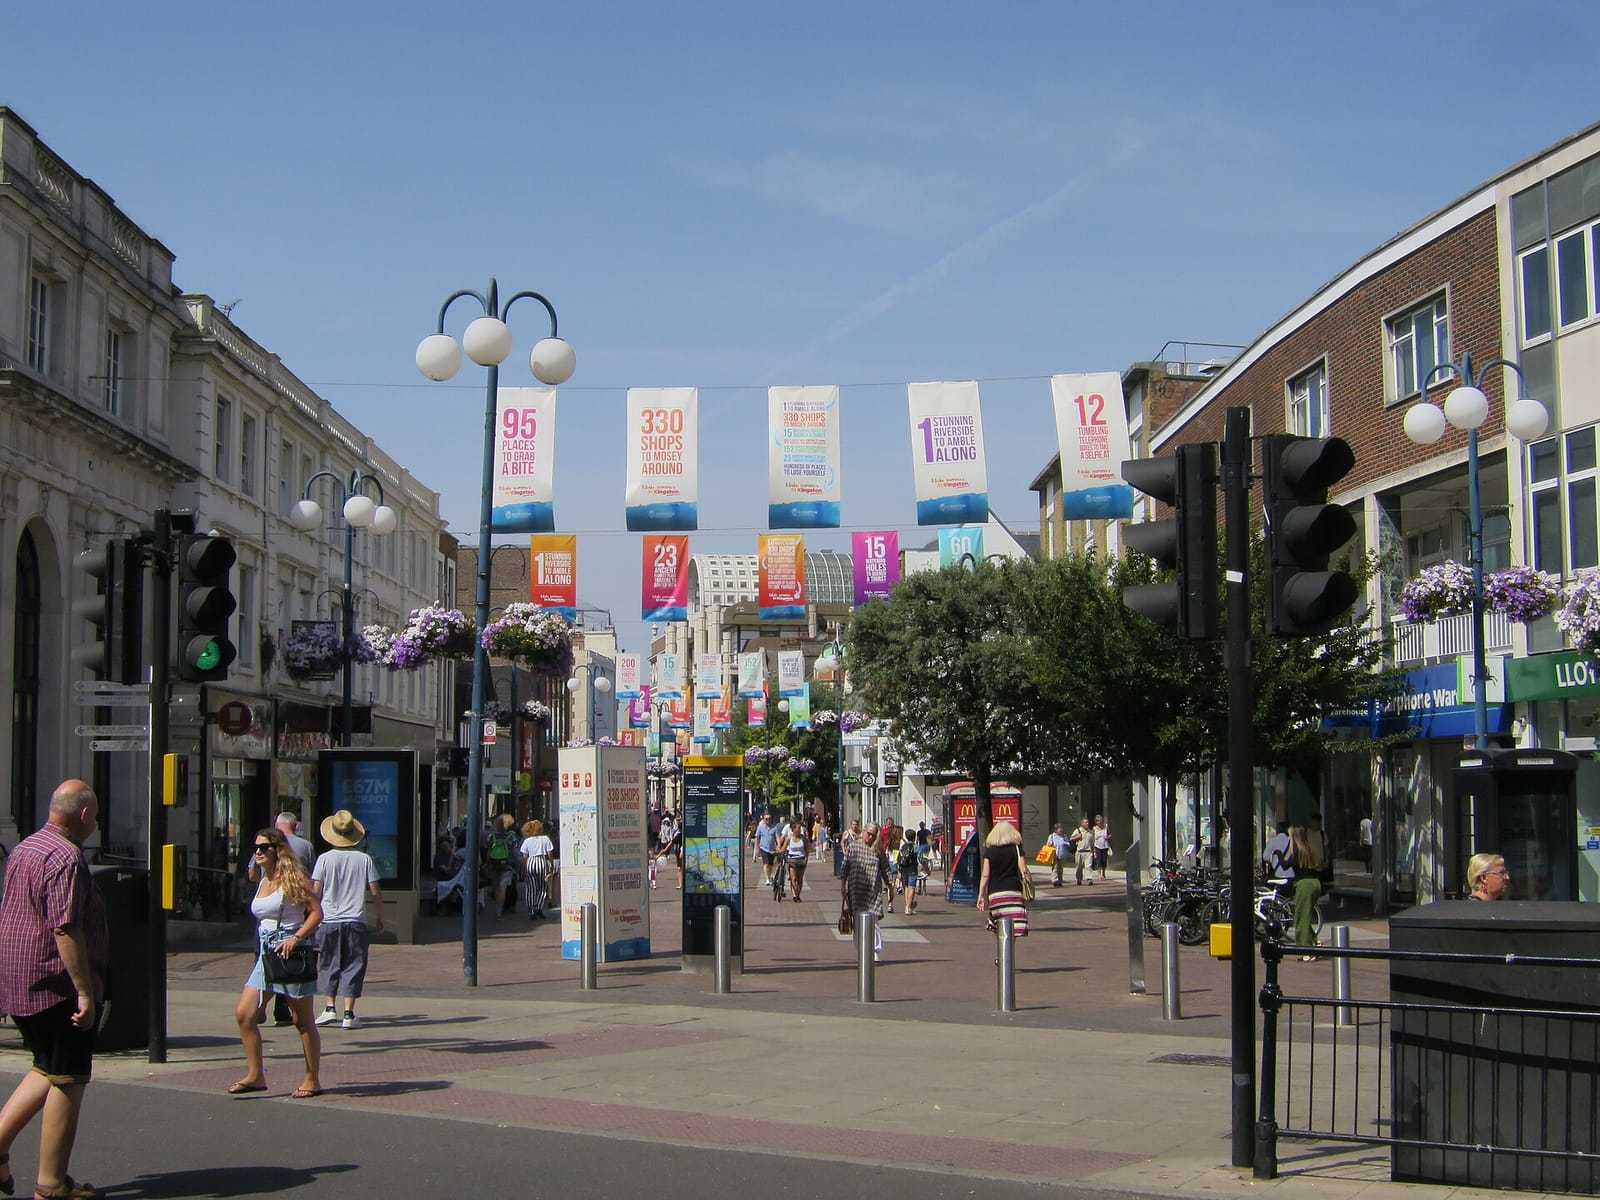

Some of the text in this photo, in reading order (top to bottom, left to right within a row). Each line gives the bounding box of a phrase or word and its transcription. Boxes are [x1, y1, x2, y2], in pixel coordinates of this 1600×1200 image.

[1074, 393, 1107, 426] 12
[502, 408, 537, 439] 95
[640, 408, 684, 434] 330
[784, 412, 826, 422] 330 SHOPS
[933, 416, 974, 427] STUNNING
[934, 426, 975, 437] RIVERSIDE
[502, 439, 536, 451] PLACES
[640, 435, 683, 451] SHOPS
[918, 417, 934, 463] 1
[935, 436, 976, 447] TO AMBLE
[1079, 435, 1109, 444] TELEPHONE
[502, 451, 536, 462] TO GRAB
[641, 451, 682, 462] TO MOSEY
[936, 446, 977, 462] ALONG
[1080, 450, 1110, 460] A SELFIE AT
[502, 461, 535, 476] A BITE
[641, 462, 683, 475] AROUND
[864, 536, 886, 558] 15
[950, 536, 972, 556] 60
[654, 544, 677, 567] 23
[534, 552, 544, 585] 1
[866, 564, 886, 572] HOLES
[545, 575, 572, 585] ALONG
[621, 658, 635, 668] 200
[664, 657, 674, 668] 15
[1432, 688, 1458, 707] War
[608, 787, 639, 801] 330 SHOPS
[608, 814, 615, 827] 15
